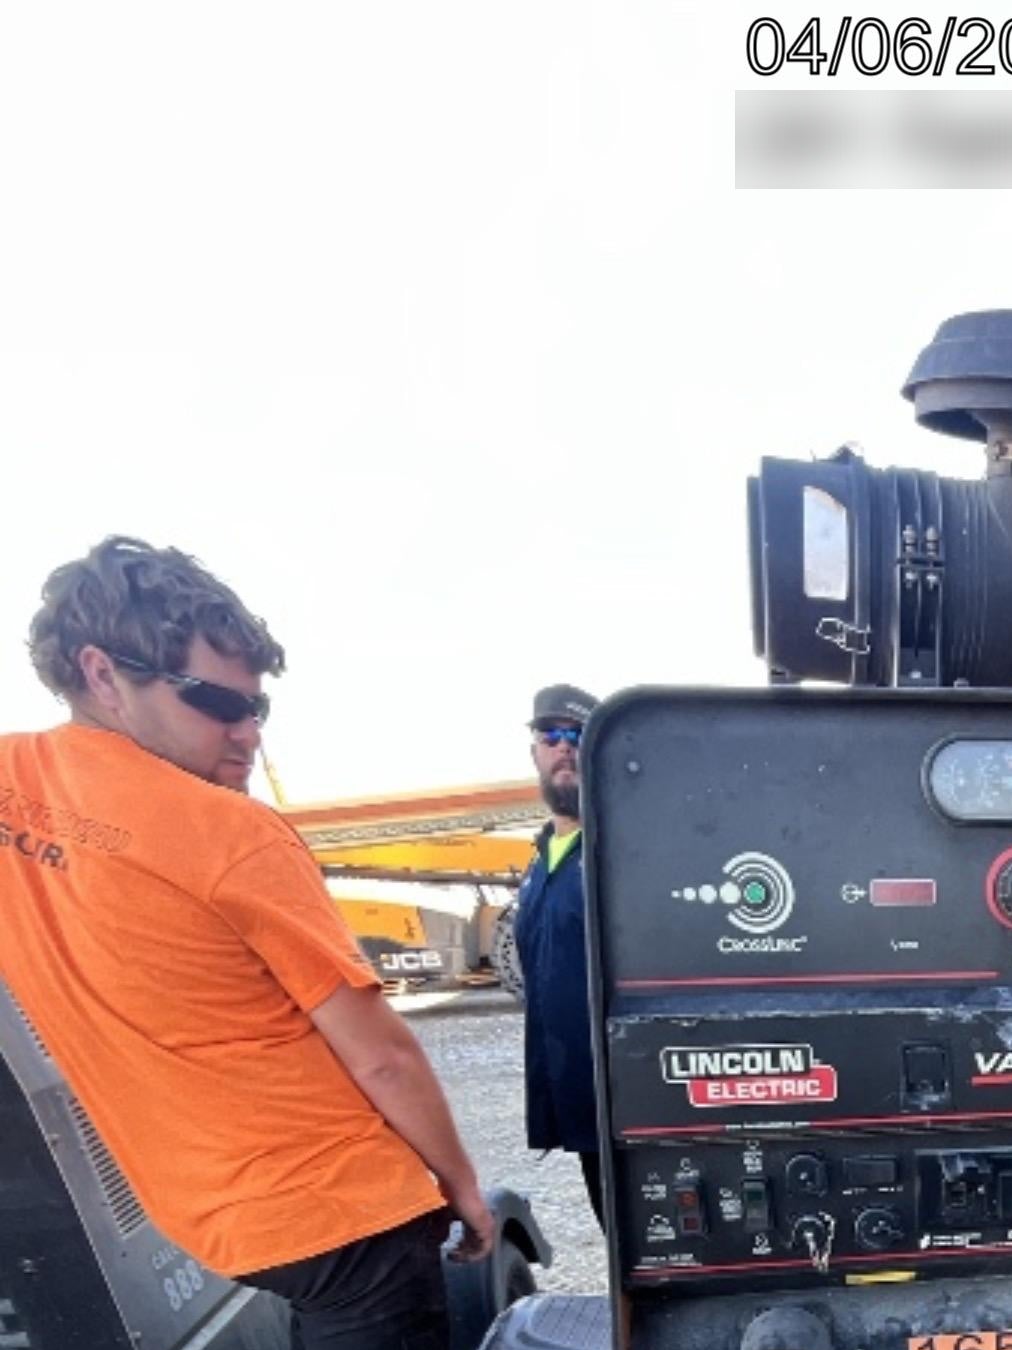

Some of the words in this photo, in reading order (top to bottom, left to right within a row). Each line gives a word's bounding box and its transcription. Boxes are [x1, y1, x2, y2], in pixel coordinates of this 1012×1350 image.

[381, 949, 442, 970] JCB
[671, 1049, 805, 1078] LINCOLN
[706, 1079, 823, 1100] ELECTRIC
